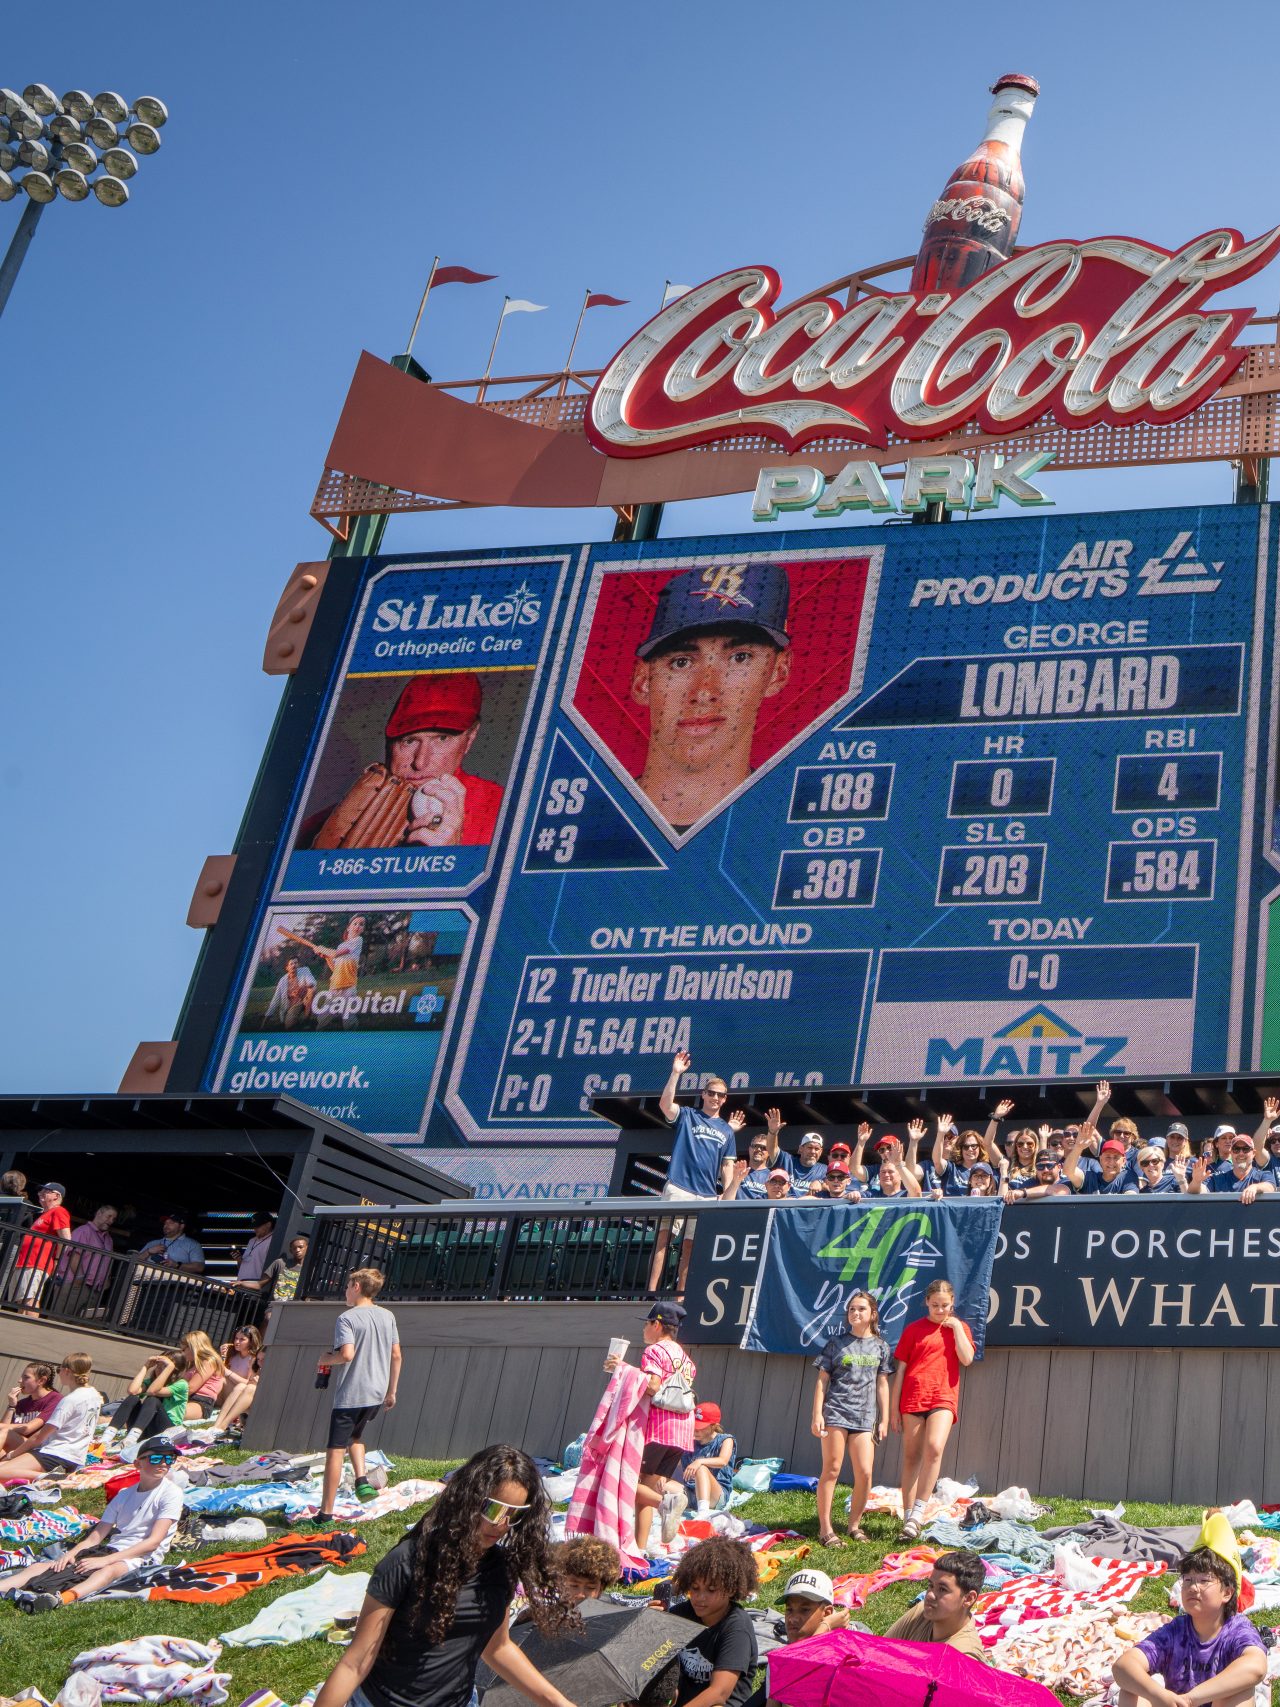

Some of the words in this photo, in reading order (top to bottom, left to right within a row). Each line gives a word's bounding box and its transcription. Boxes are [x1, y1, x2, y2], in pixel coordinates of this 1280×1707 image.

[753, 451, 1056, 522] PARK
[1057, 540, 1133, 571] AIR
[909, 568, 1131, 608] PRODUCTS
[374, 637, 477, 660] Orthopedic
[480, 634, 523, 654] Care
[1002, 619, 1149, 650] GEORGE
[959, 655, 1180, 718] LOMBARD
[817, 740, 877, 761] AVG
[983, 735, 1025, 755] HR
[1145, 728, 1196, 749] RBI
[546, 778, 589, 816] SS
[807, 772, 876, 812] .188
[990, 767, 1013, 807] 0
[1156, 762, 1179, 802] 4
[537, 825, 578, 864] #3
[802, 827, 866, 848] OBP
[965, 821, 1026, 843] SLG
[1131, 817, 1197, 838] OPS
[317, 854, 457, 876] 1-866-STLUKES
[792, 859, 861, 900] .381
[951, 854, 1030, 897] .203
[1121, 849, 1201, 893] .584
[589, 926, 636, 950] ON
[638, 925, 700, 949] THE
[701, 923, 813, 947] MOUND
[988, 917, 1094, 941] TODAY
[526, 967, 558, 1003] 12
[569, 966, 663, 1003] Tucker
[664, 963, 794, 1002] Davidson
[1007, 953, 1060, 991] 0-0
[311, 990, 407, 1020] Capital
[239, 1039, 309, 1064] More
[511, 1018, 556, 1056] 2-1
[573, 1016, 639, 1056] 5.64
[640, 1015, 692, 1055] ERA
[924, 1036, 1130, 1077] MAITZ
[230, 1065, 370, 1094] glovework.
